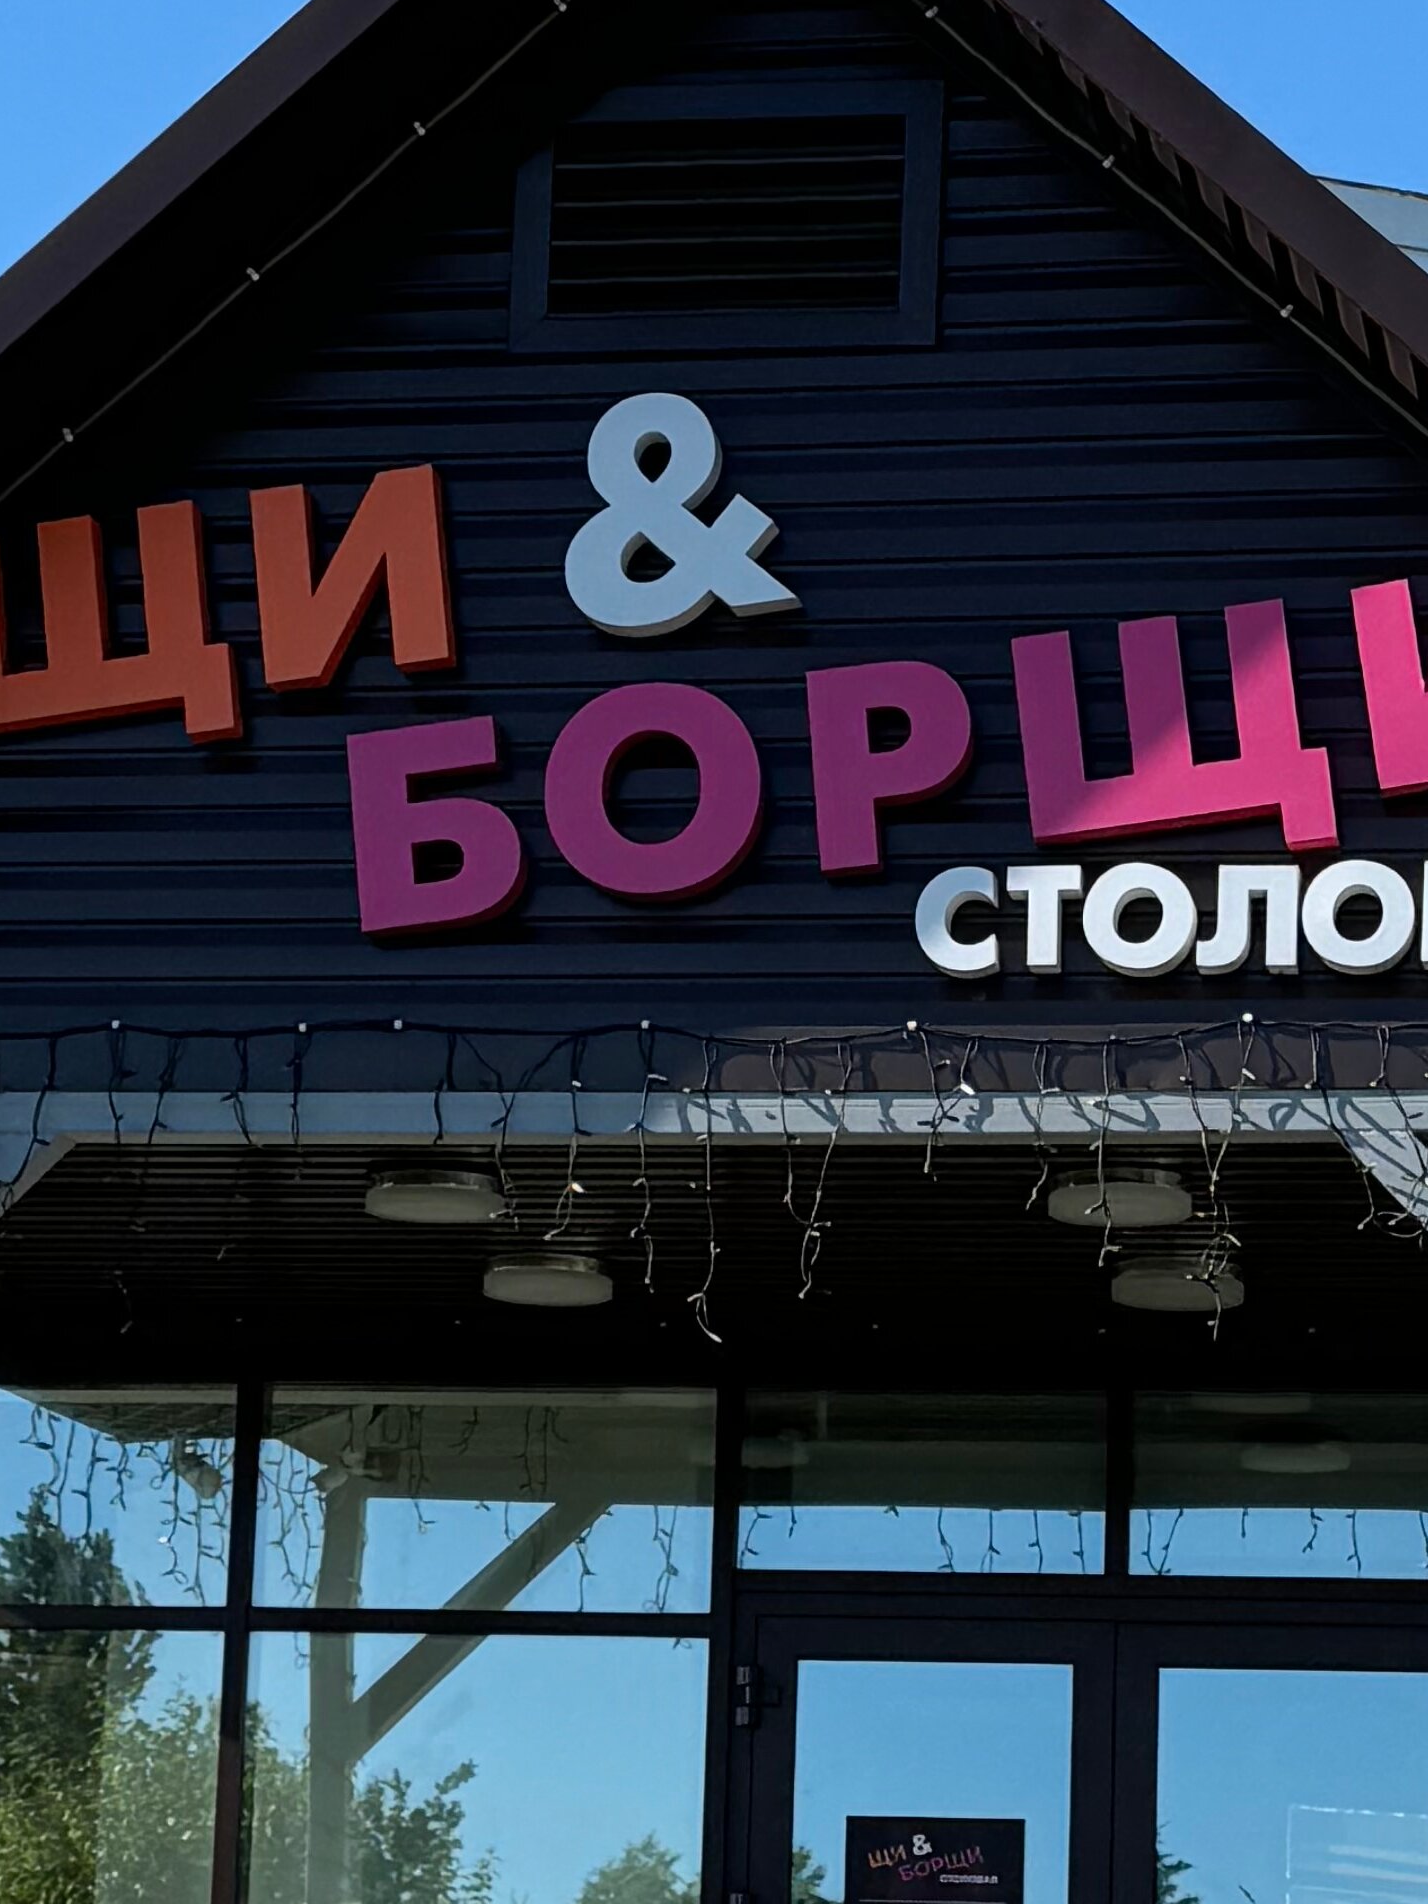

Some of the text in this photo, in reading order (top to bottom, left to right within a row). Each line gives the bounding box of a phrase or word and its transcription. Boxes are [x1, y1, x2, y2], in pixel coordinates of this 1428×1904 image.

[564, 392, 803, 638] &
[898, 1845, 984, 1882] БОРЩИ
[912, 1834, 933, 1856] &
